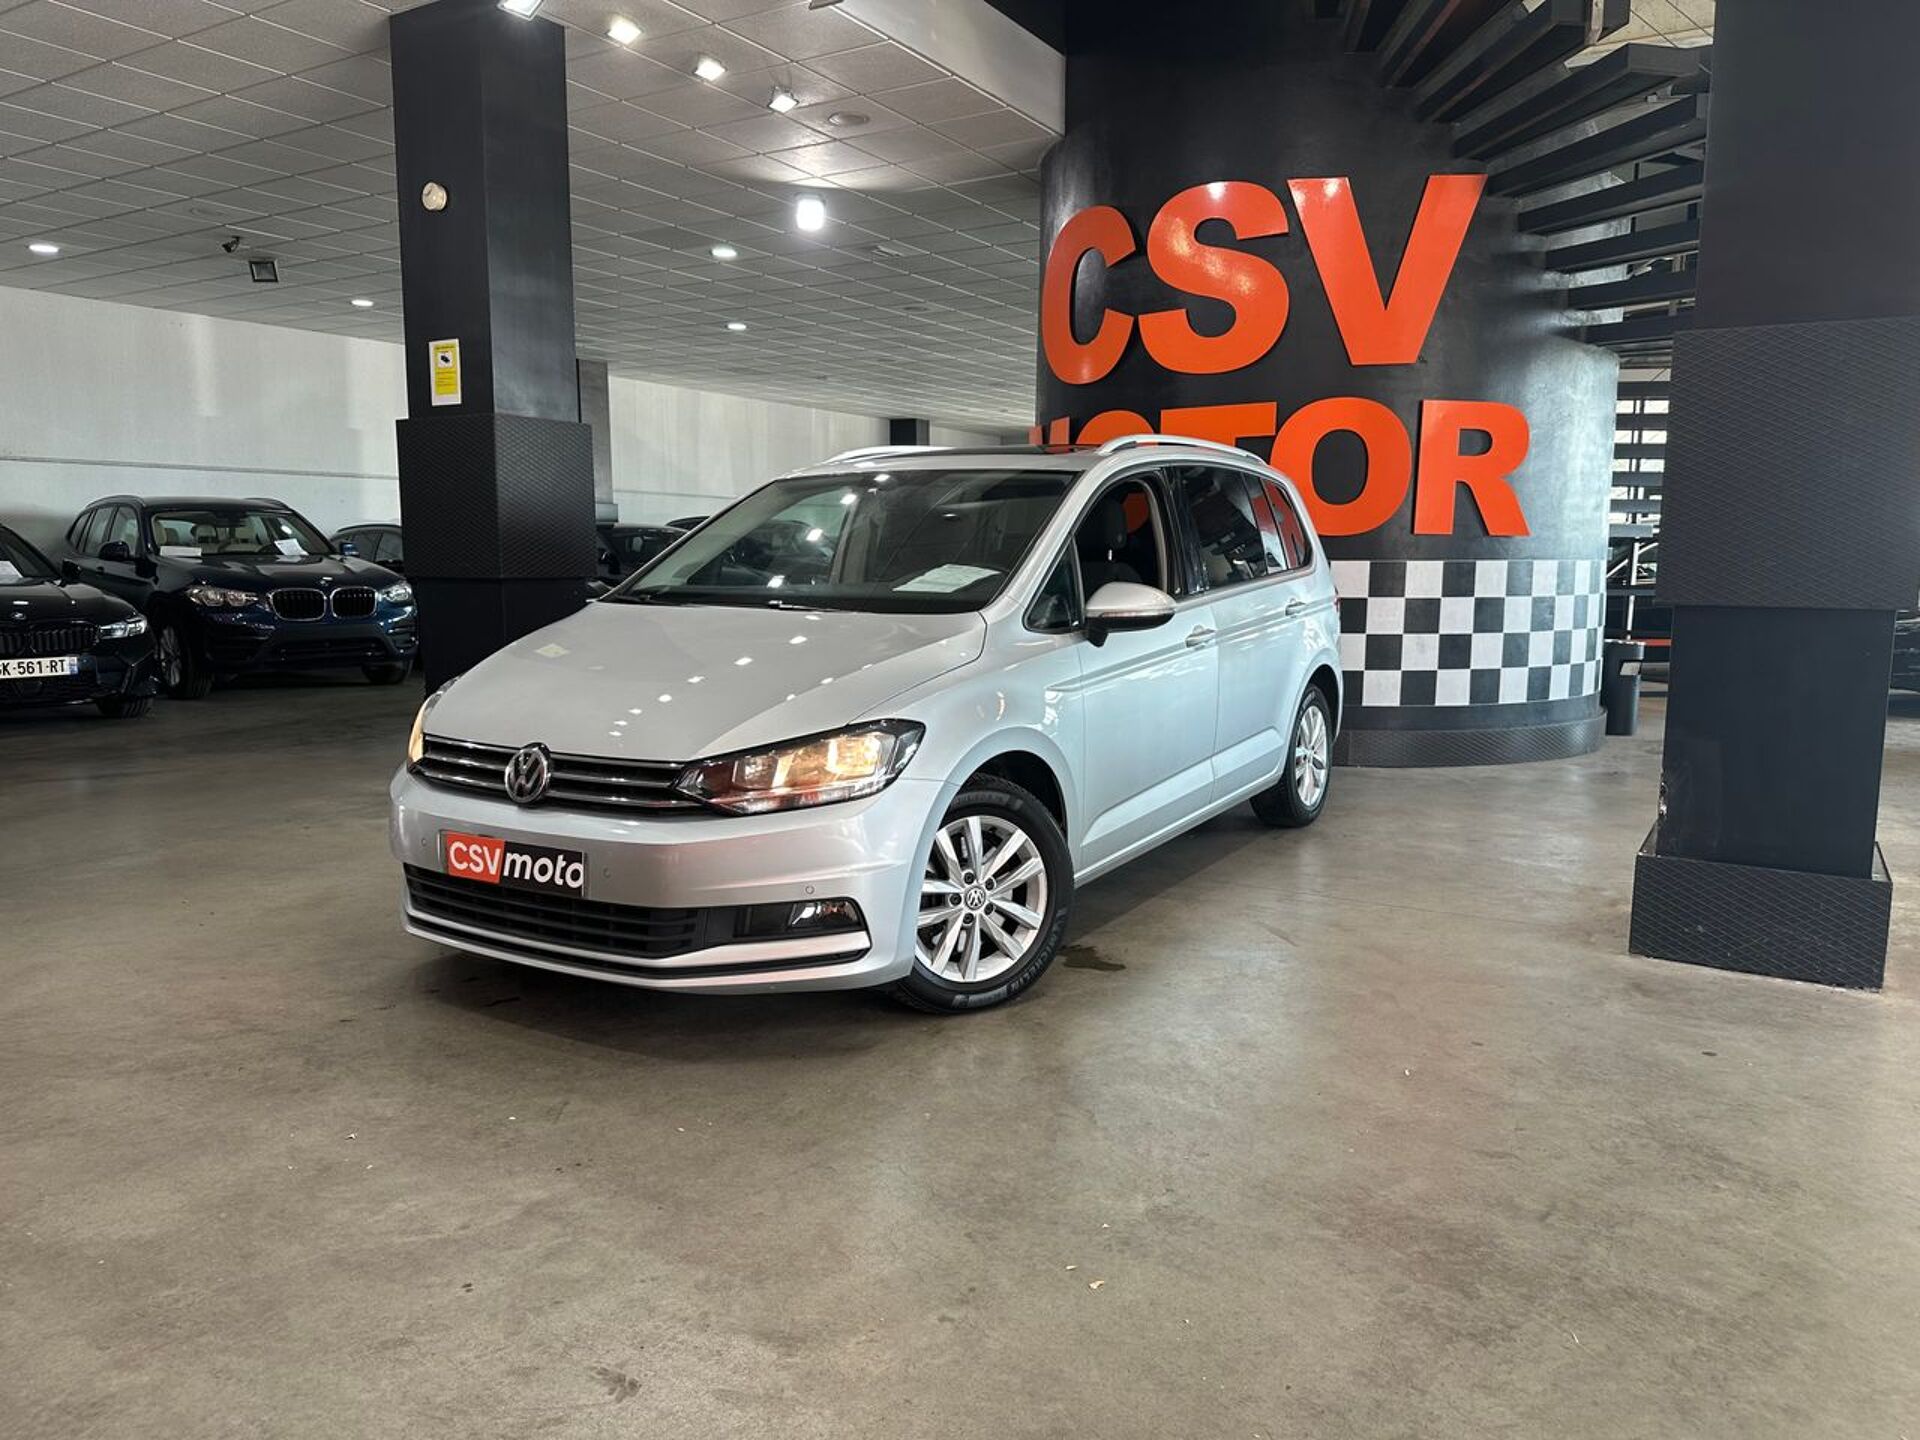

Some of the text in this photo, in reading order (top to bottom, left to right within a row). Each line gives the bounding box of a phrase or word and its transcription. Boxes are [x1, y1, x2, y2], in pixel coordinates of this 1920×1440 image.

[1042, 174, 1488, 385] CSV
[1029, 397, 1530, 537] TOR
[0, 659, 66, 676] K-561-RT
